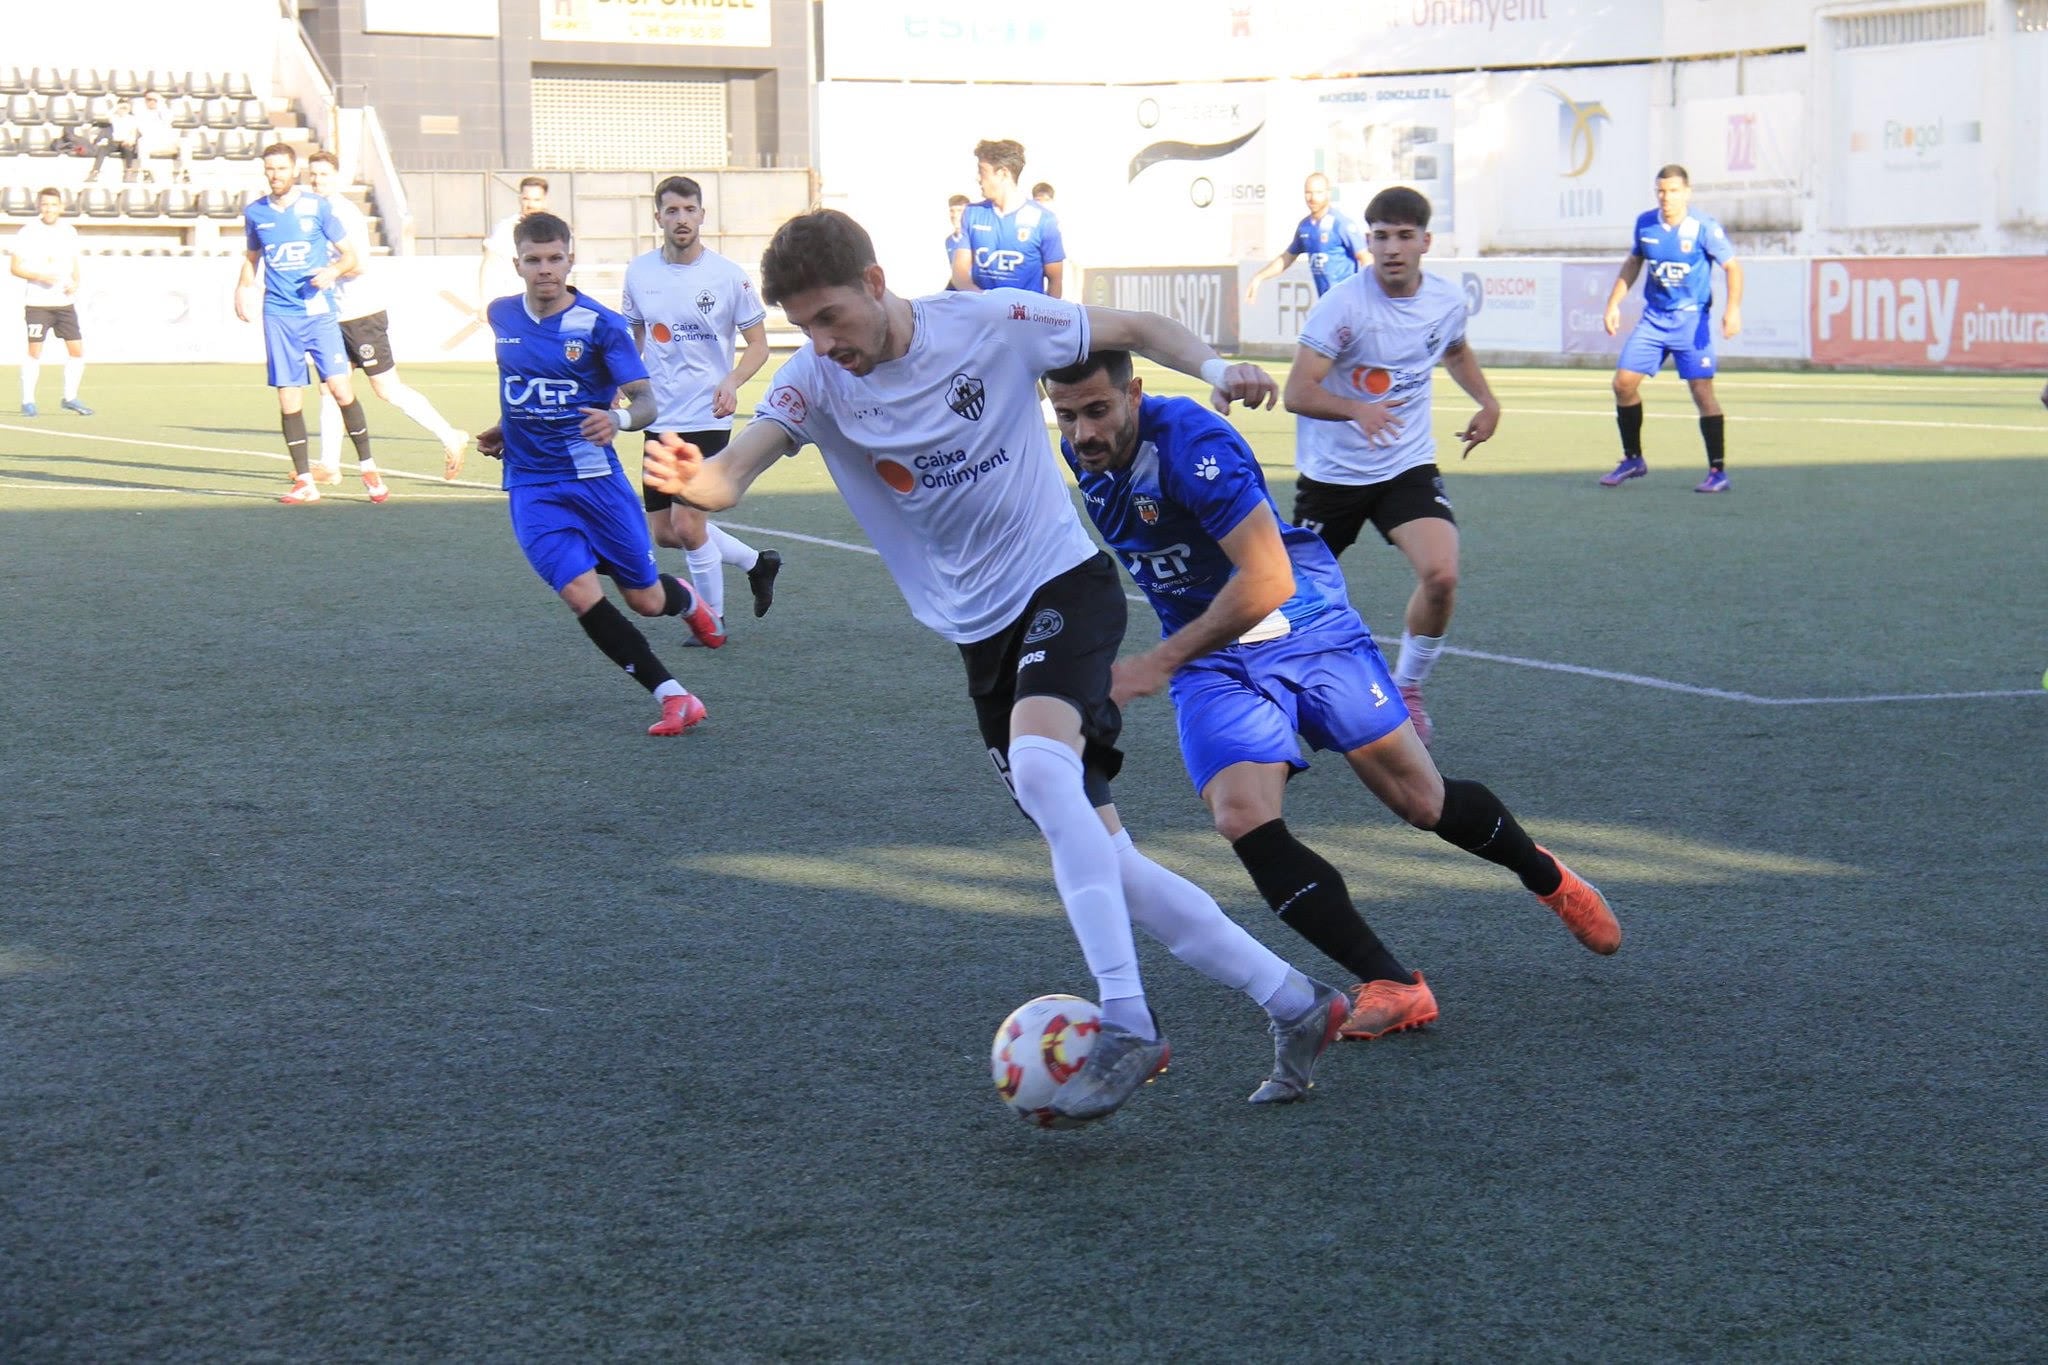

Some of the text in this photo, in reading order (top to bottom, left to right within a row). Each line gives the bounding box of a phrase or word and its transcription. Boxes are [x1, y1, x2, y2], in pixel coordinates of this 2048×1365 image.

[671, 322, 699, 332] Caixa
[914, 449, 967, 470] Caixa
[921, 447, 1010, 489] Ontinyent
